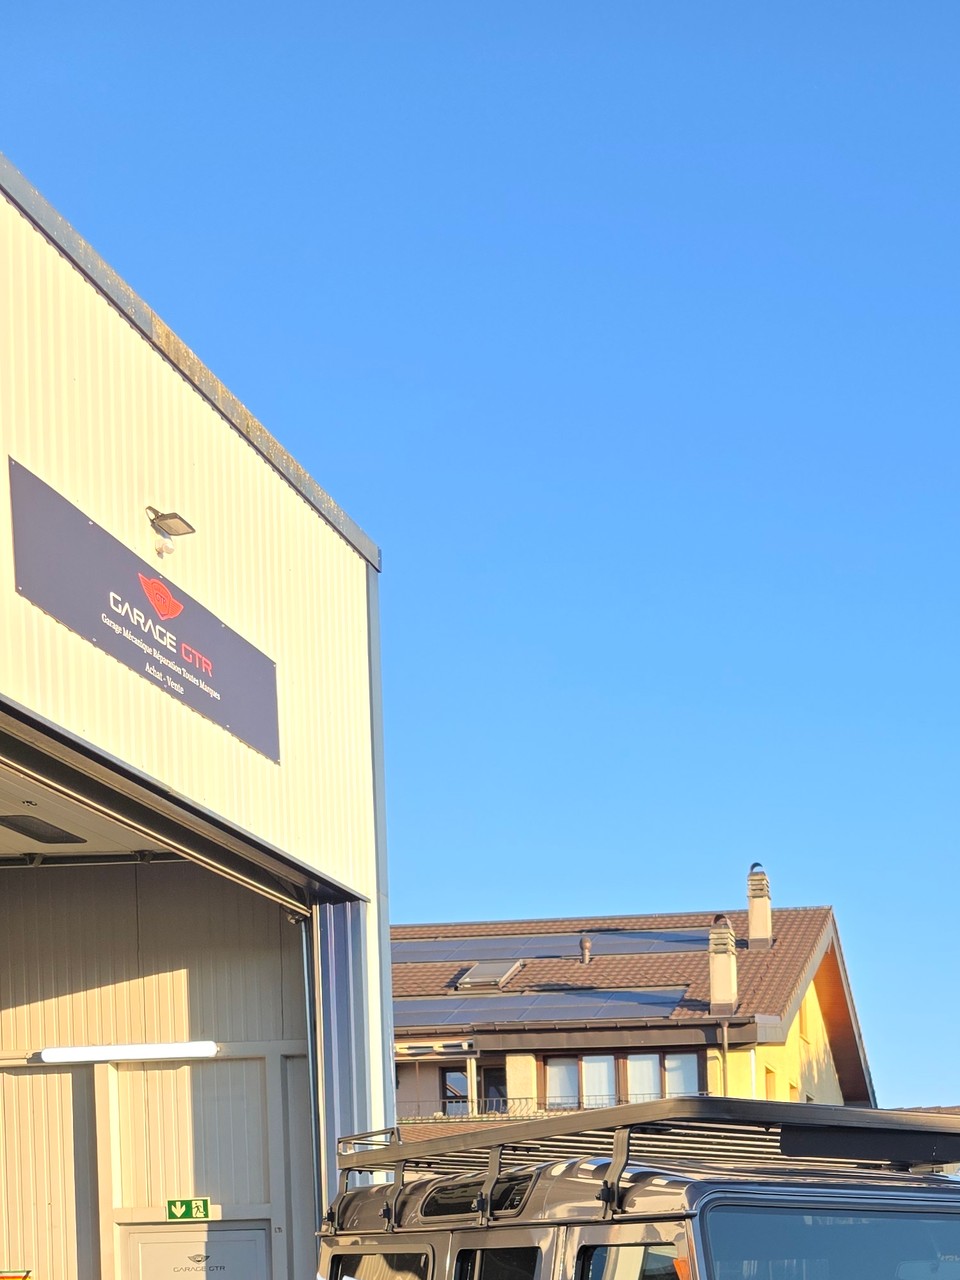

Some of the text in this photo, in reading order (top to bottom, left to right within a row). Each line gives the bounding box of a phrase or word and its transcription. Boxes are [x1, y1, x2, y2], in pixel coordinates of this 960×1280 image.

[101, 613, 221, 700] Garage Mécanique Réparation Toutes Marques
[109, 591, 213, 678] GARAGE GTR
[145, 662, 163, 682] Achat
[166, 675, 185, 695] Vente
